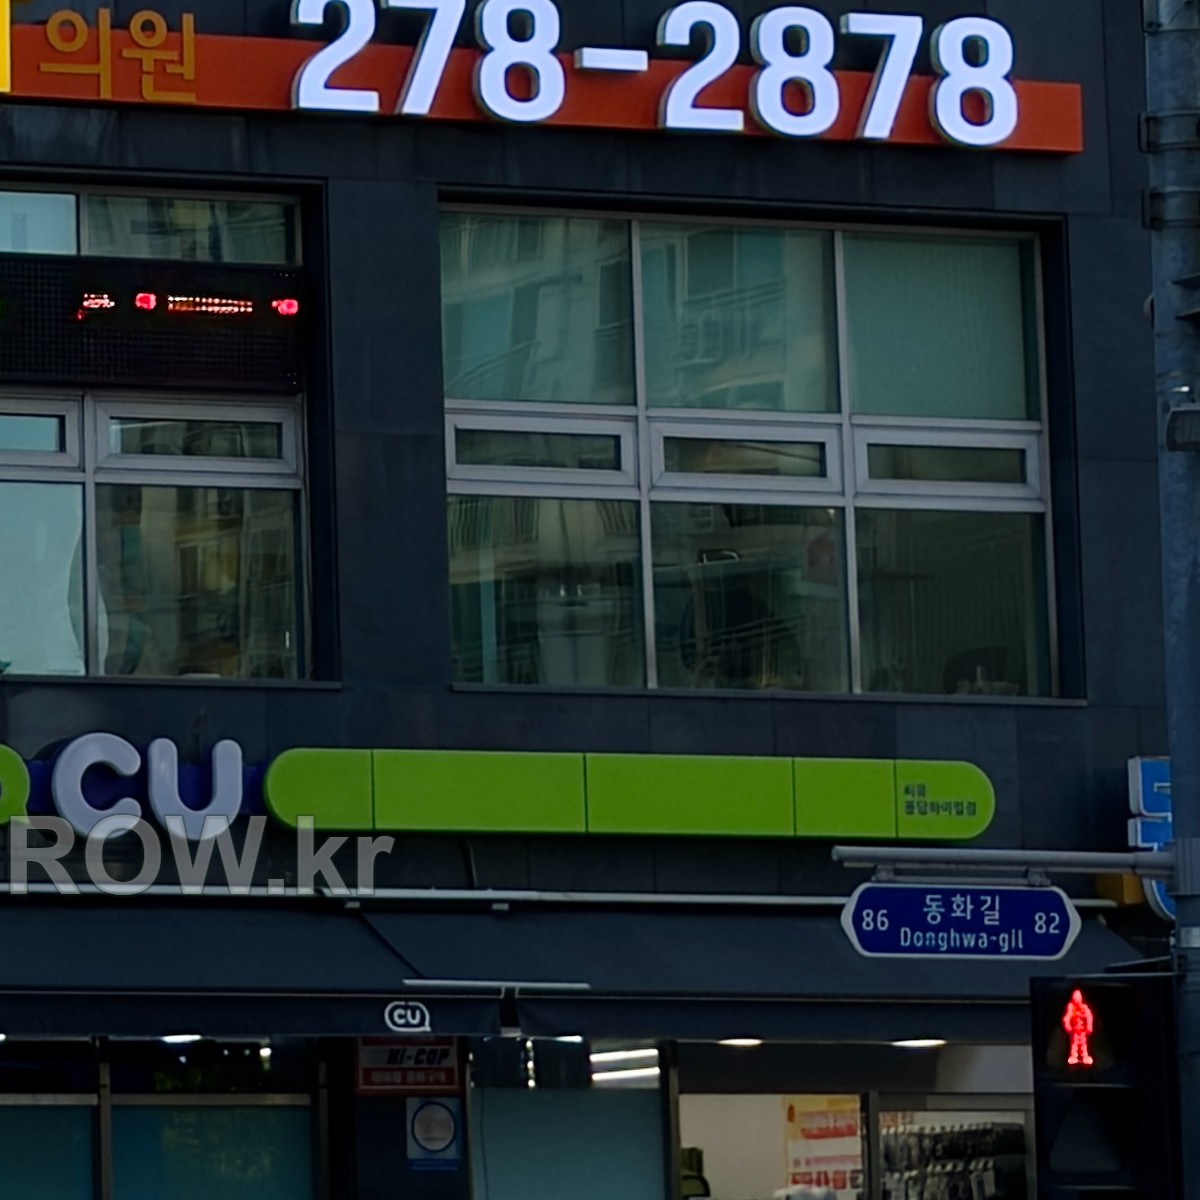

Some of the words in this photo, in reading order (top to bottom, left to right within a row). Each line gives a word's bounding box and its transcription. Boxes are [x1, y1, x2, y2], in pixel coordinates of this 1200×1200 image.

[52, 732, 243, 841] CU
[862, 909, 889, 931] 86
[923, 894, 1000, 925] 동화길
[1034, 912, 1060, 934] 82
[900, 927, 1024, 952] Donghwa-gil
[393, 1008, 421, 1025] CU
